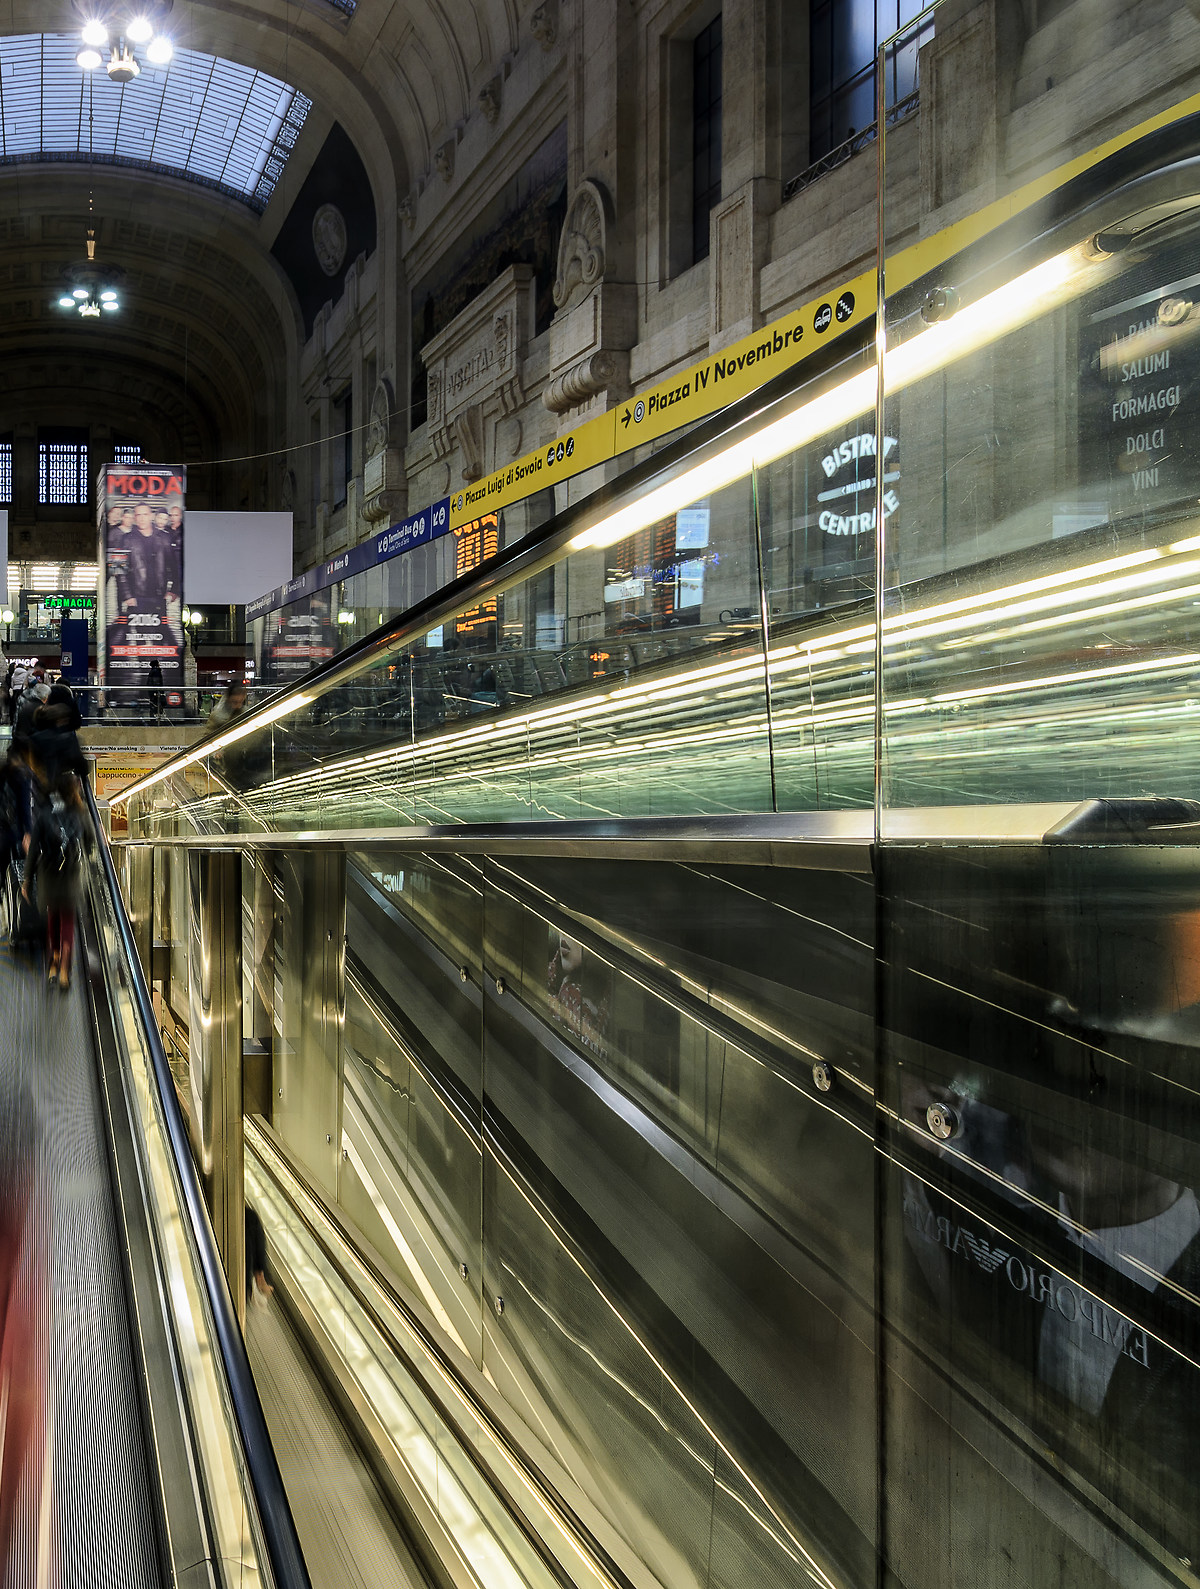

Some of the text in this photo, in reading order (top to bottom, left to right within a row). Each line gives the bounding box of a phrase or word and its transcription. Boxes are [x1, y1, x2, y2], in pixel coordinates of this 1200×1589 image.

[649, 325, 804, 415] Piazza IV Novembre
[1121, 350, 1170, 382] SALUMI
[1112, 385, 1180, 422] FORMAGGI
[1126, 429, 1164, 456] DOLCI
[466, 457, 543, 506] Piazza Luigi di Savoia
[1131, 467, 1159, 491] VINI
[45, 598, 93, 608] FARMACIA
